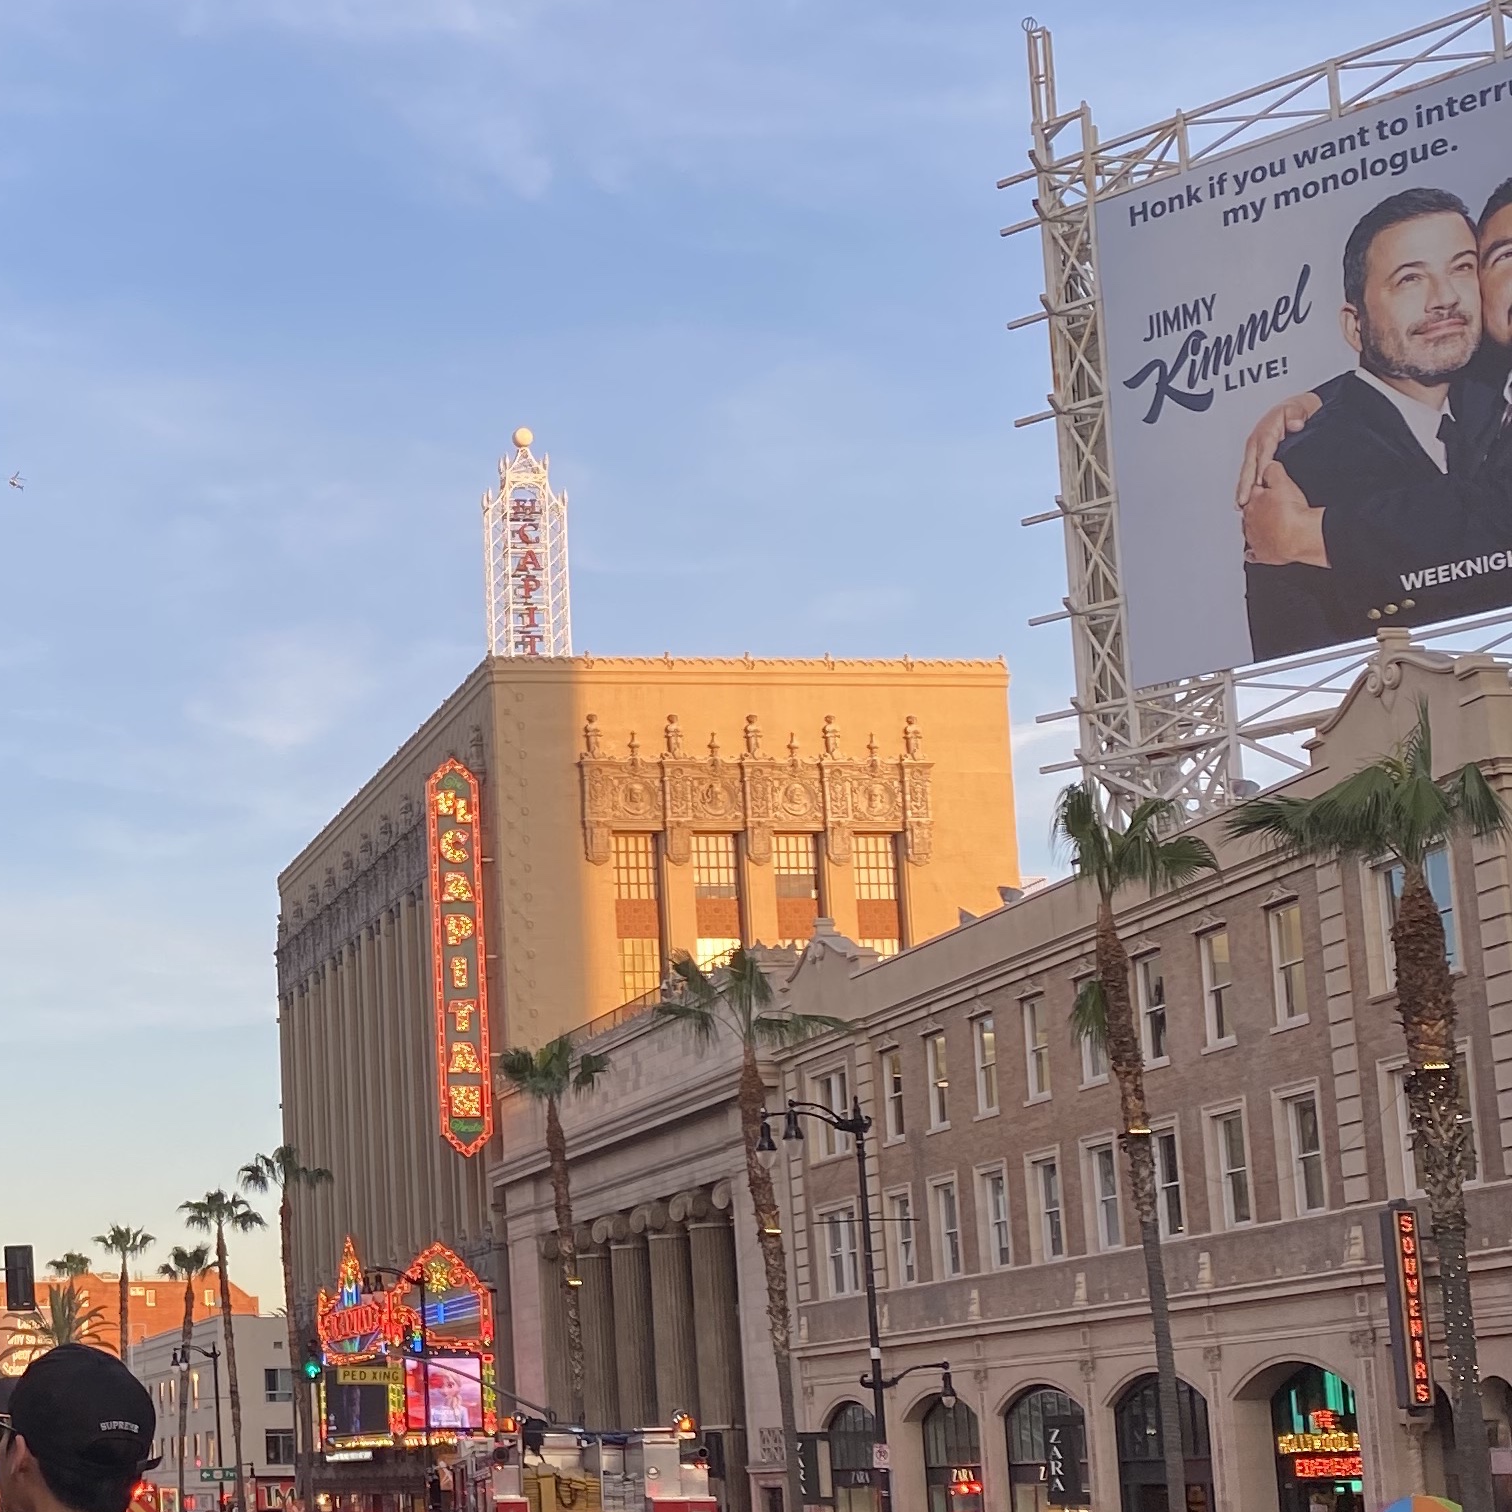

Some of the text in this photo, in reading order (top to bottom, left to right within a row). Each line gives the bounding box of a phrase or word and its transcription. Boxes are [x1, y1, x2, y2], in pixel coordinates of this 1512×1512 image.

[1129, 184, 1203, 227] Honk
[1208, 172, 1230, 200] if
[1232, 157, 1286, 196] you
[1292, 126, 1371, 170] want
[1375, 118, 1409, 141] to
[1222, 137, 1459, 227] my monologue.
[1122, 263, 1313, 424] Kimmel
[1142, 293, 1217, 342] JIMMY
[1224, 356, 1289, 391] LIVE!
[1399, 1214, 1430, 1403] SOUVENIRS
[342, 1370, 400, 1382] PED XING
[851, 1470, 871, 1485] ZARA
[951, 1468, 975, 1483] ZARA
[1049, 1428, 1066, 1493] ZARA
